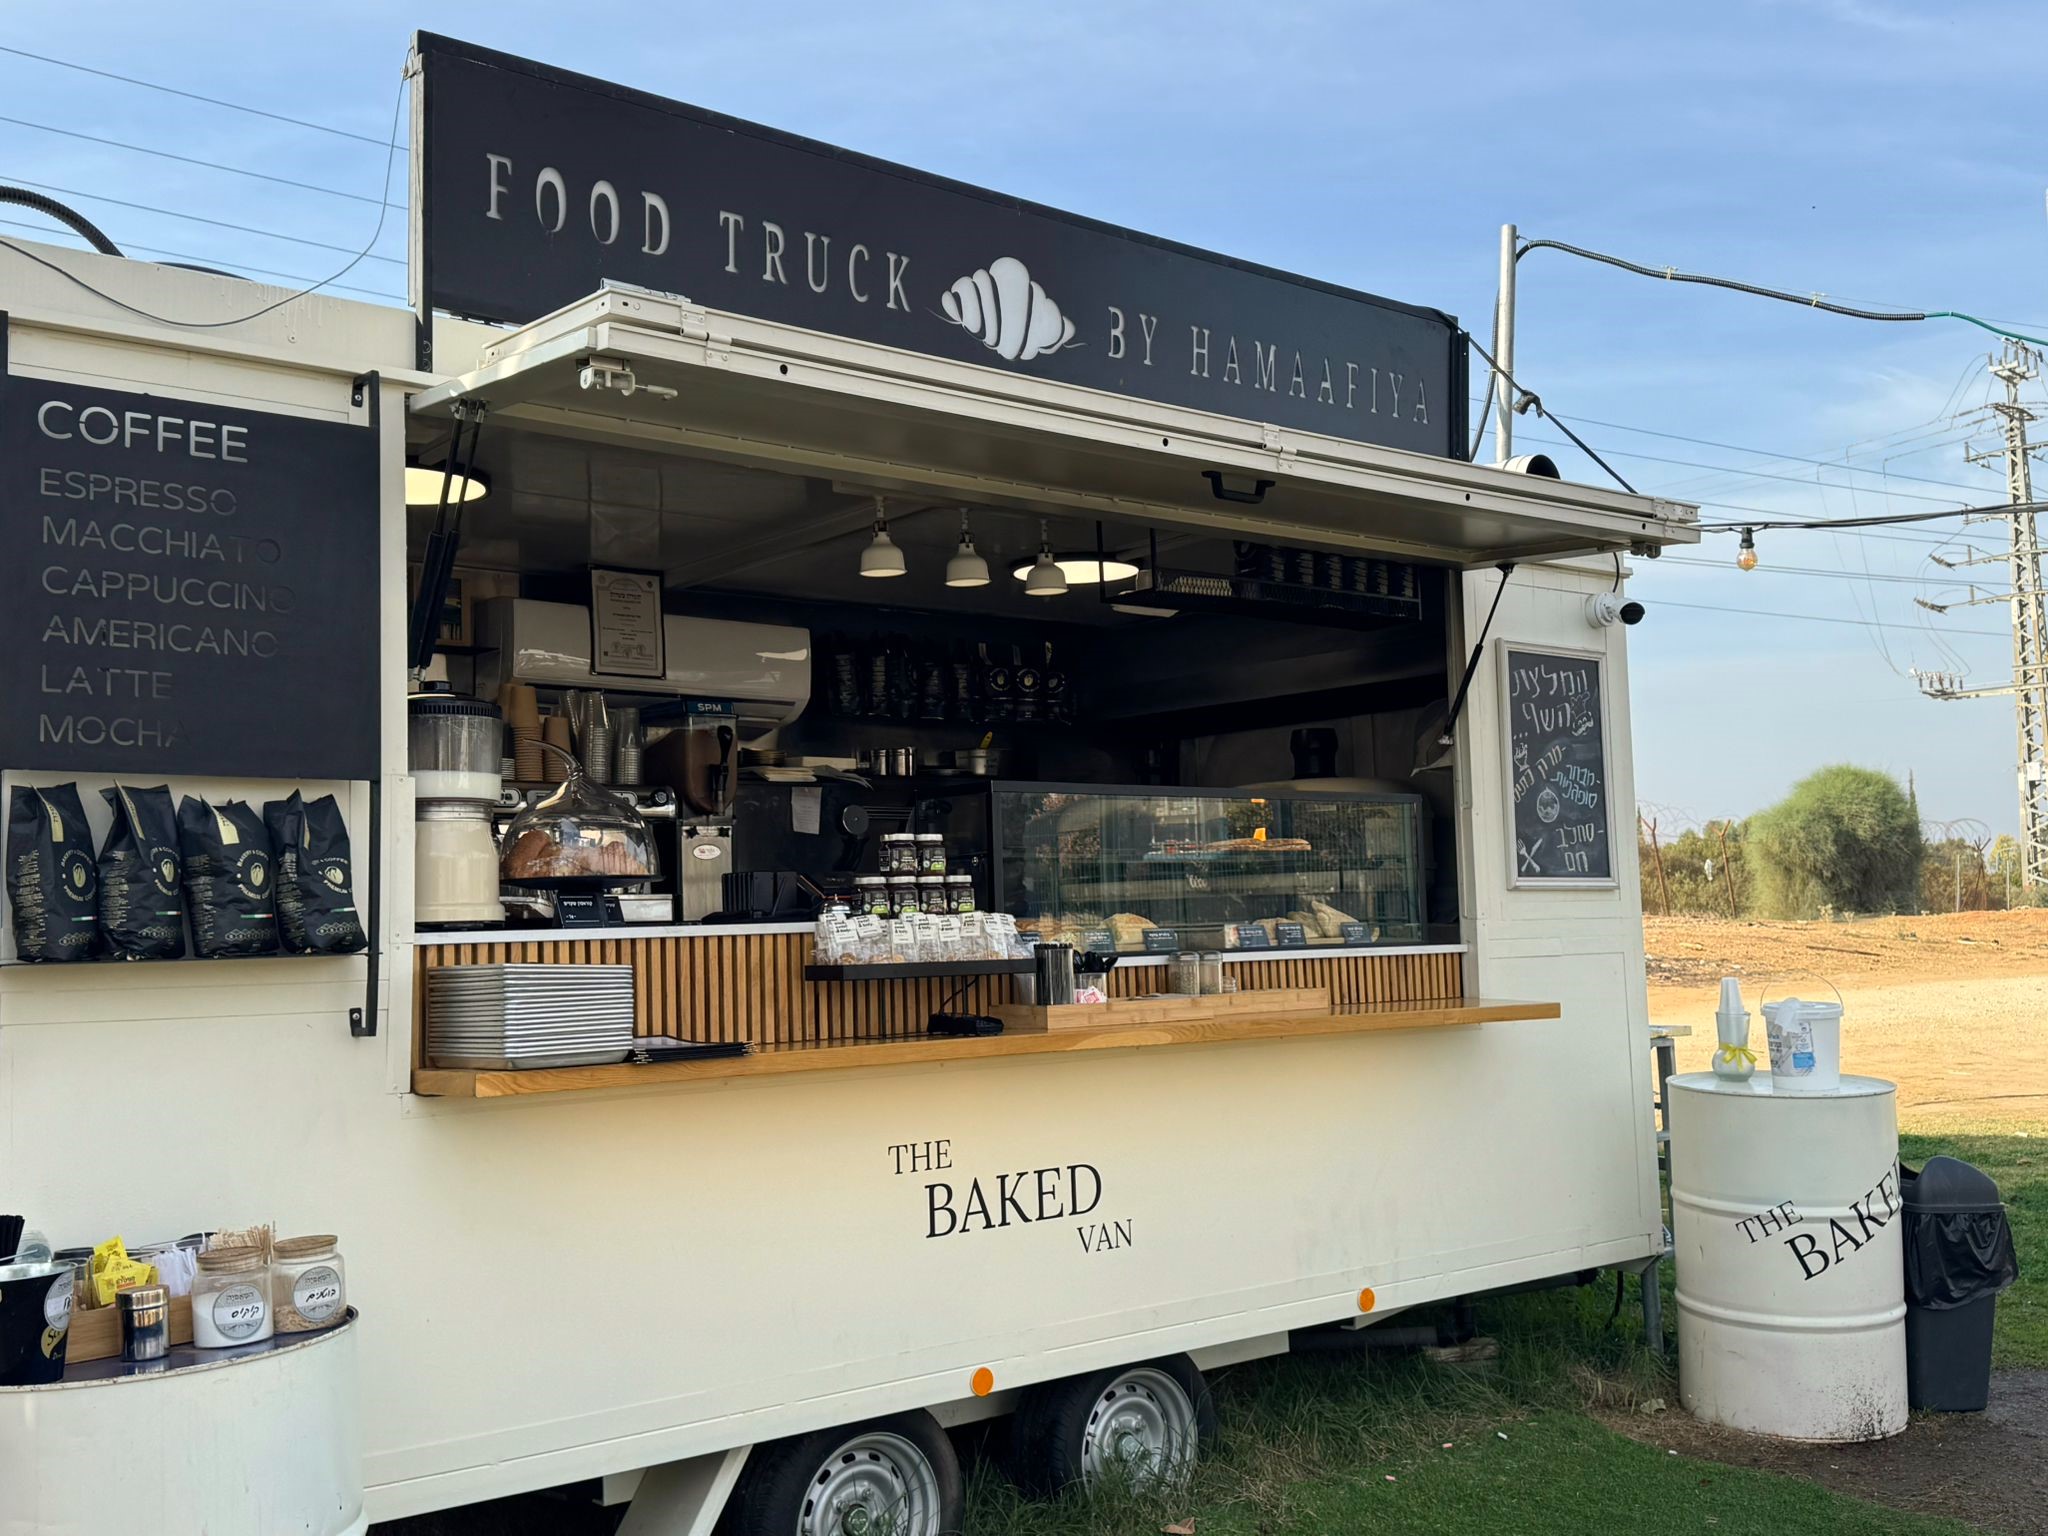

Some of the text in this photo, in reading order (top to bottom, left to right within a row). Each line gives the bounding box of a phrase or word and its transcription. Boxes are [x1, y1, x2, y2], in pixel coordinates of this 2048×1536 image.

[486, 152, 1429, 425] FOOD TRUCK BY HAMAAFIYA
[37, 400, 248, 463] COFFEE
[40, 467, 237, 515] ESPRESSO
[42, 615, 279, 658] AMERICANO
[41, 664, 173, 699] LATTE
[697, 703, 722, 712] SPM
[1522, 703, 1570, 734] השף
[1564, 851, 1589, 873] חם
[887, 1139, 952, 1175] THE
[924, 1163, 1102, 1239] BAKED
[1076, 1219, 1132, 1254] VAN
[1735, 1200, 1804, 1244] THE
[231, 1305, 260, 1319] קוקוס
